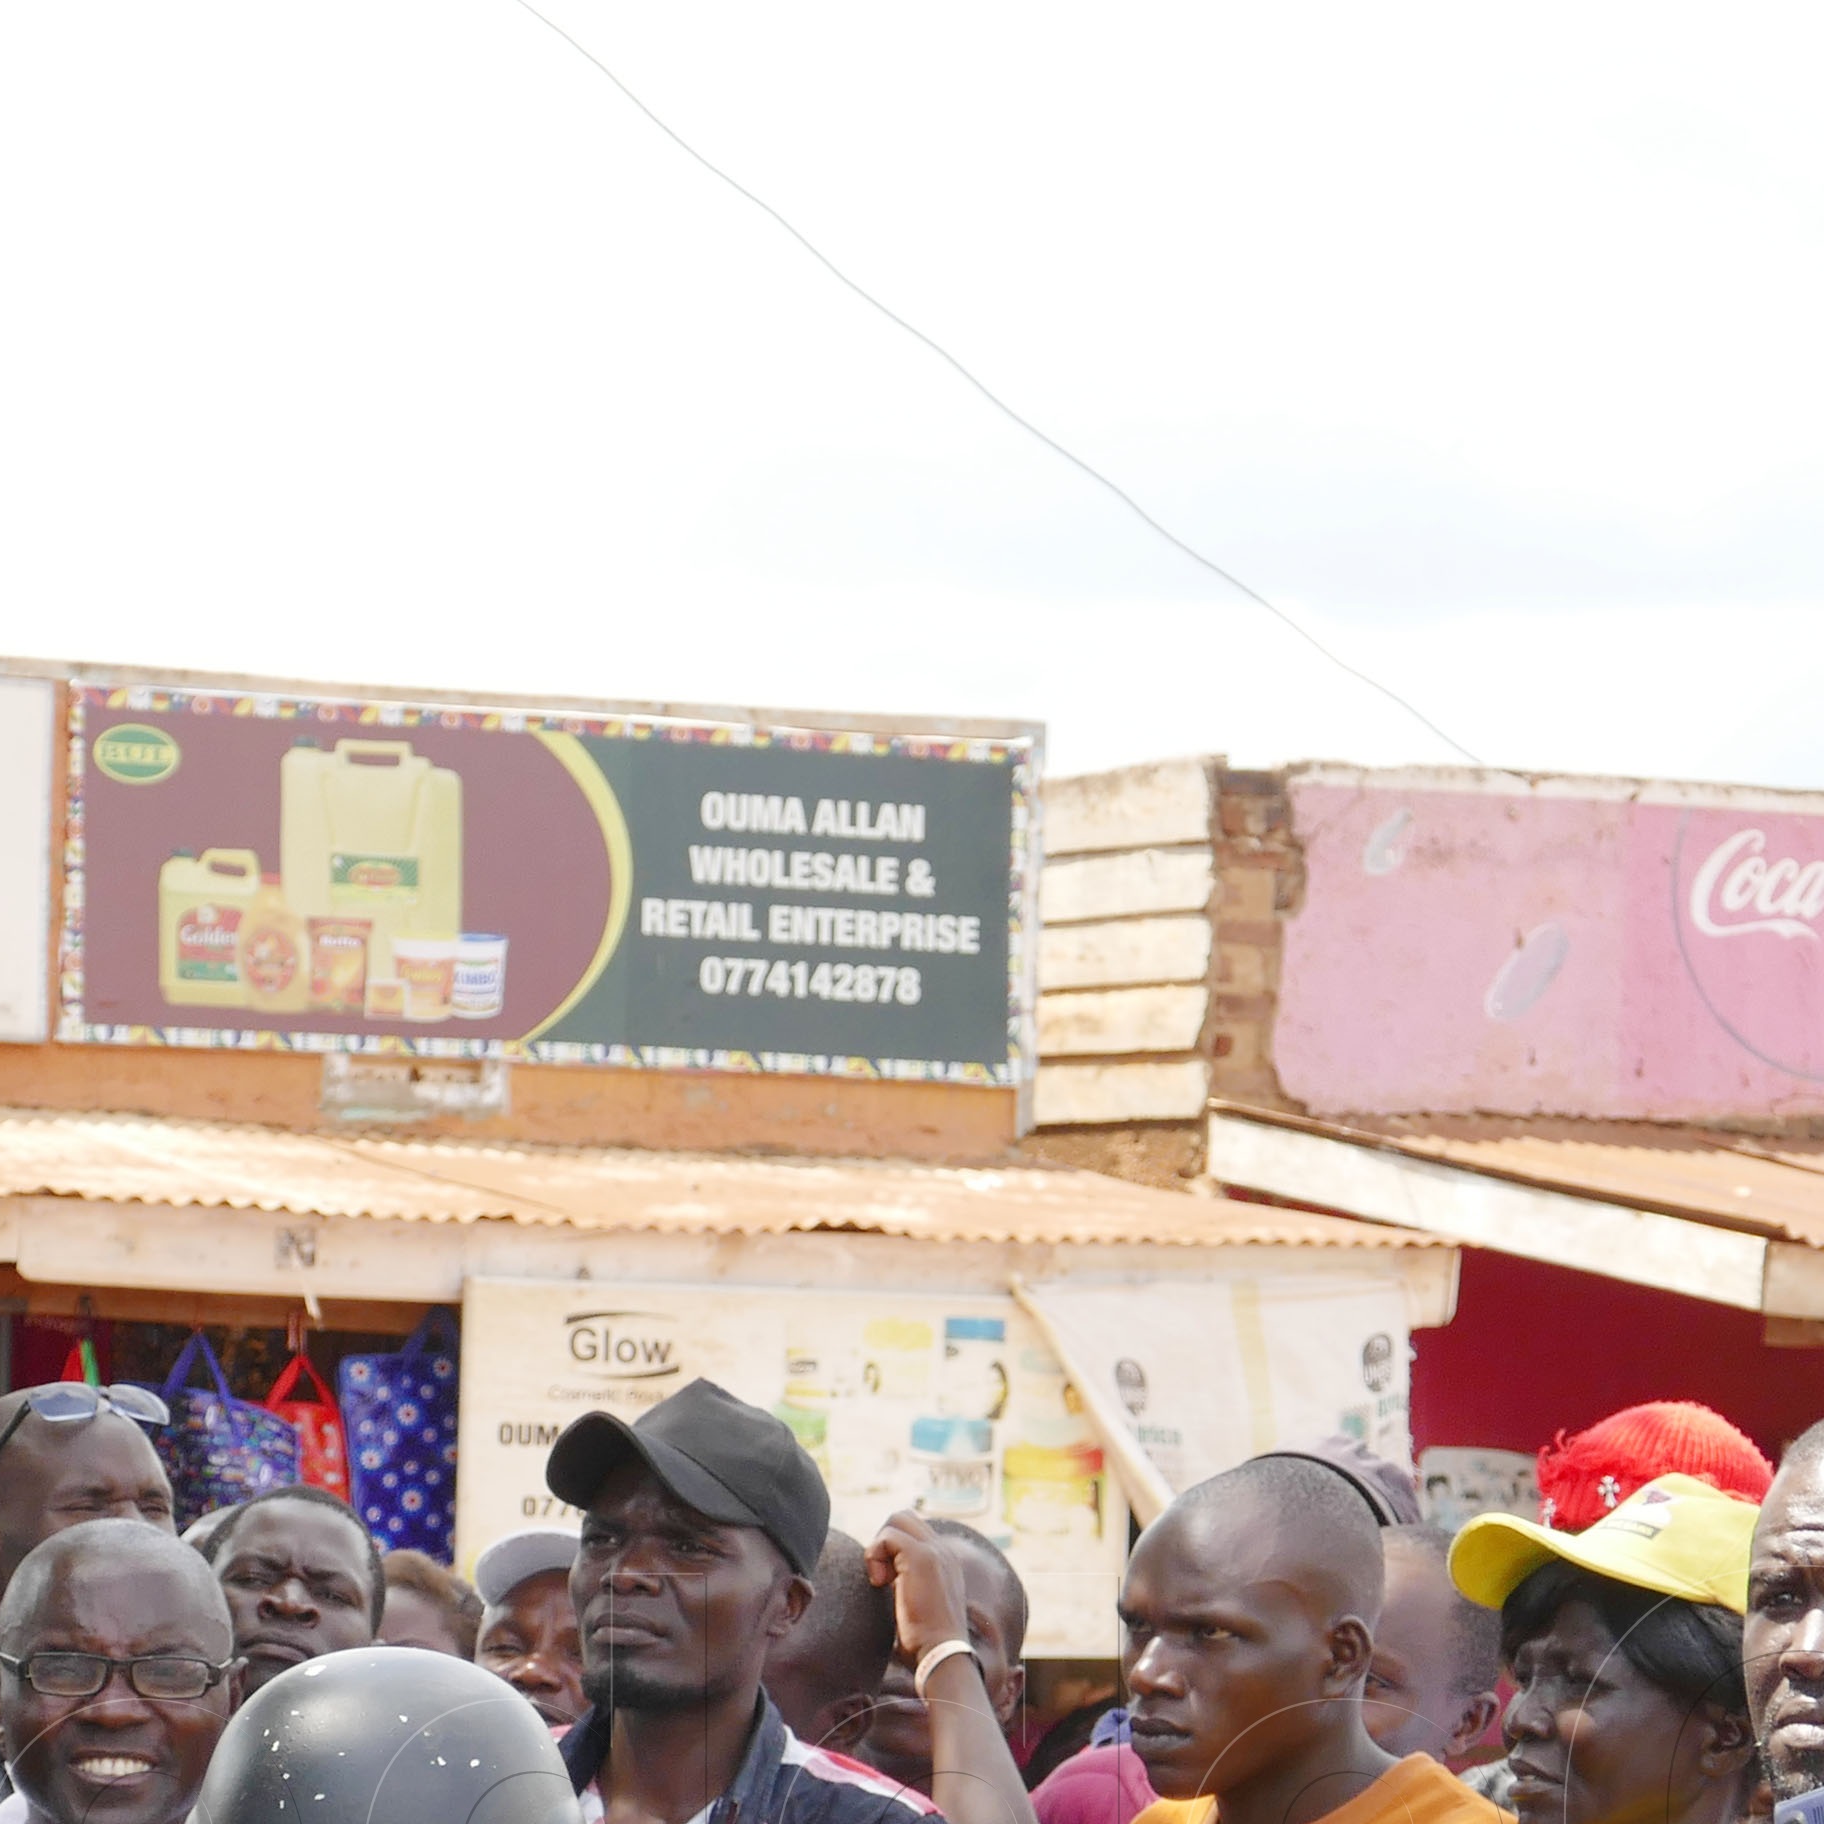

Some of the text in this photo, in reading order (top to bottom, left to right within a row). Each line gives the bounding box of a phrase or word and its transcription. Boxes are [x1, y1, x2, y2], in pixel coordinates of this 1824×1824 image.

[700, 791, 925, 843] OUMA ALLAN
[688, 845, 937, 898] WHOLESALE &
[640, 897, 981, 954] RETAIL ENTERPRISE
[699, 956, 922, 1006] 0774142878
[569, 1327, 672, 1364] Glow
